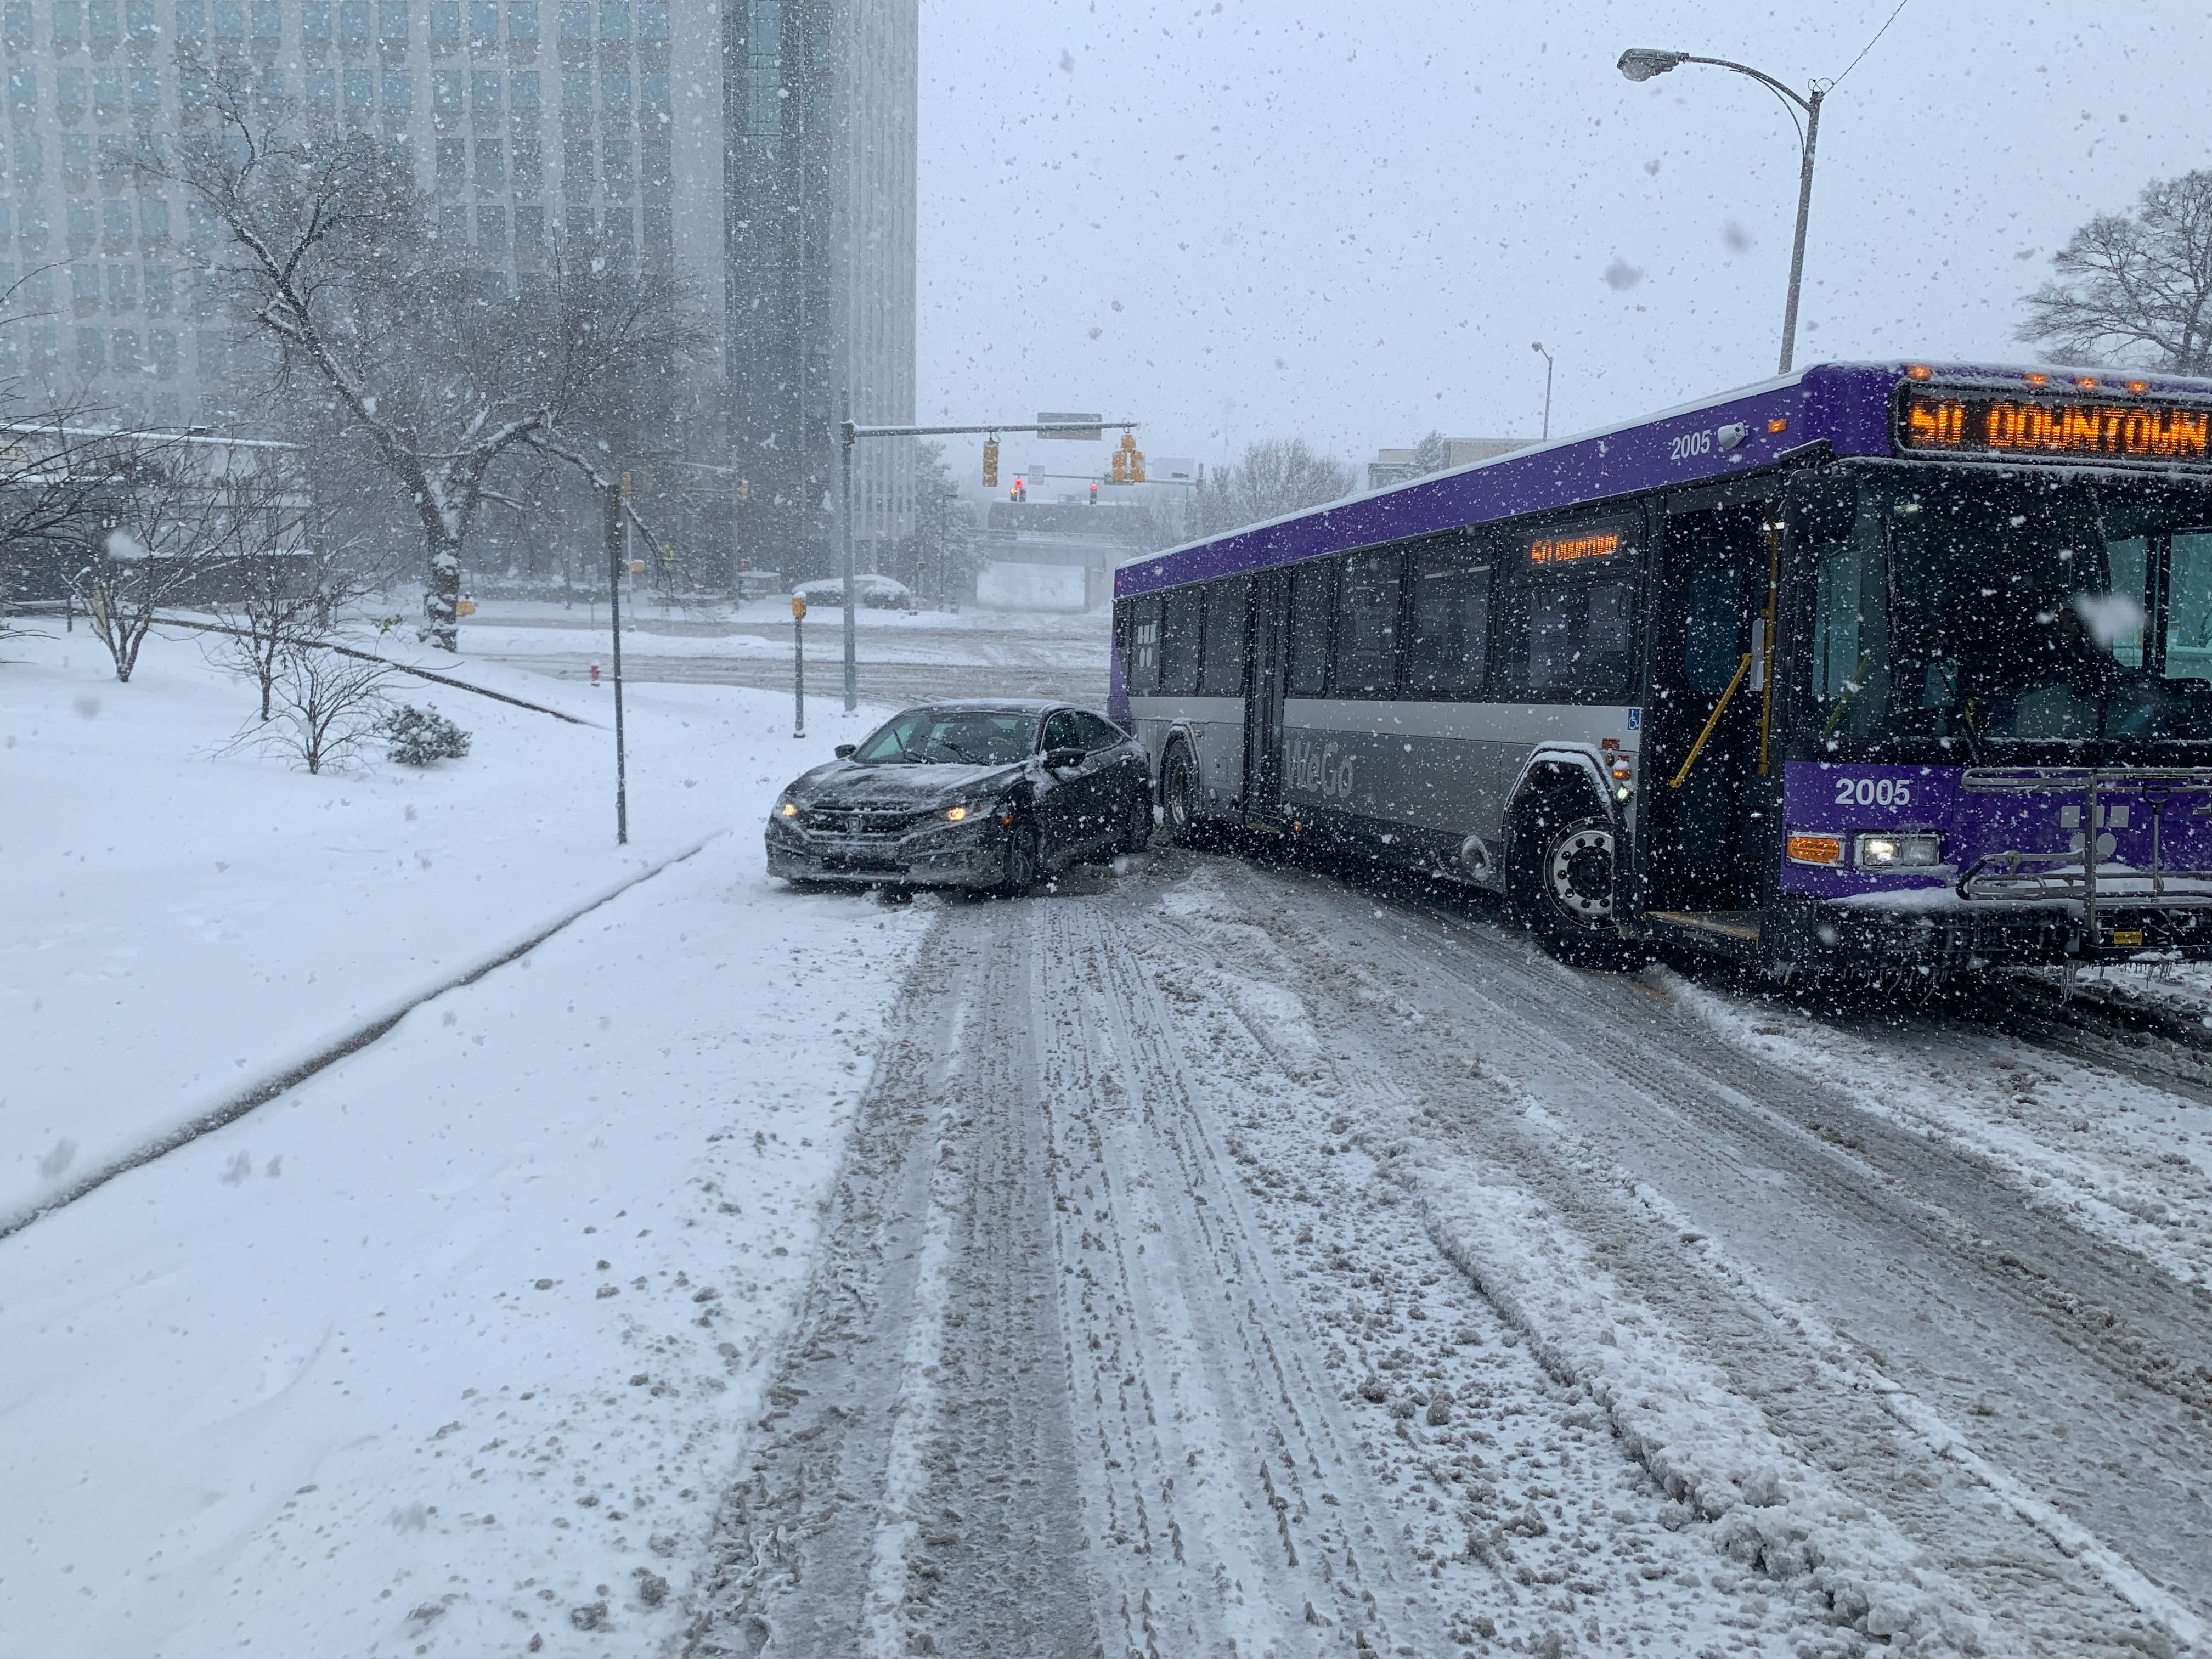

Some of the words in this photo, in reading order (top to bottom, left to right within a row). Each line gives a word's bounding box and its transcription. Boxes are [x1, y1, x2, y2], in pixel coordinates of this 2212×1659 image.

[1671, 430, 1711, 461] 2005
[1911, 396, 1962, 444] 50
[1989, 399, 2208, 456] DOWNTOWN
[1285, 740, 1353, 798] WeGo
[1835, 778, 1910, 805] 2005
